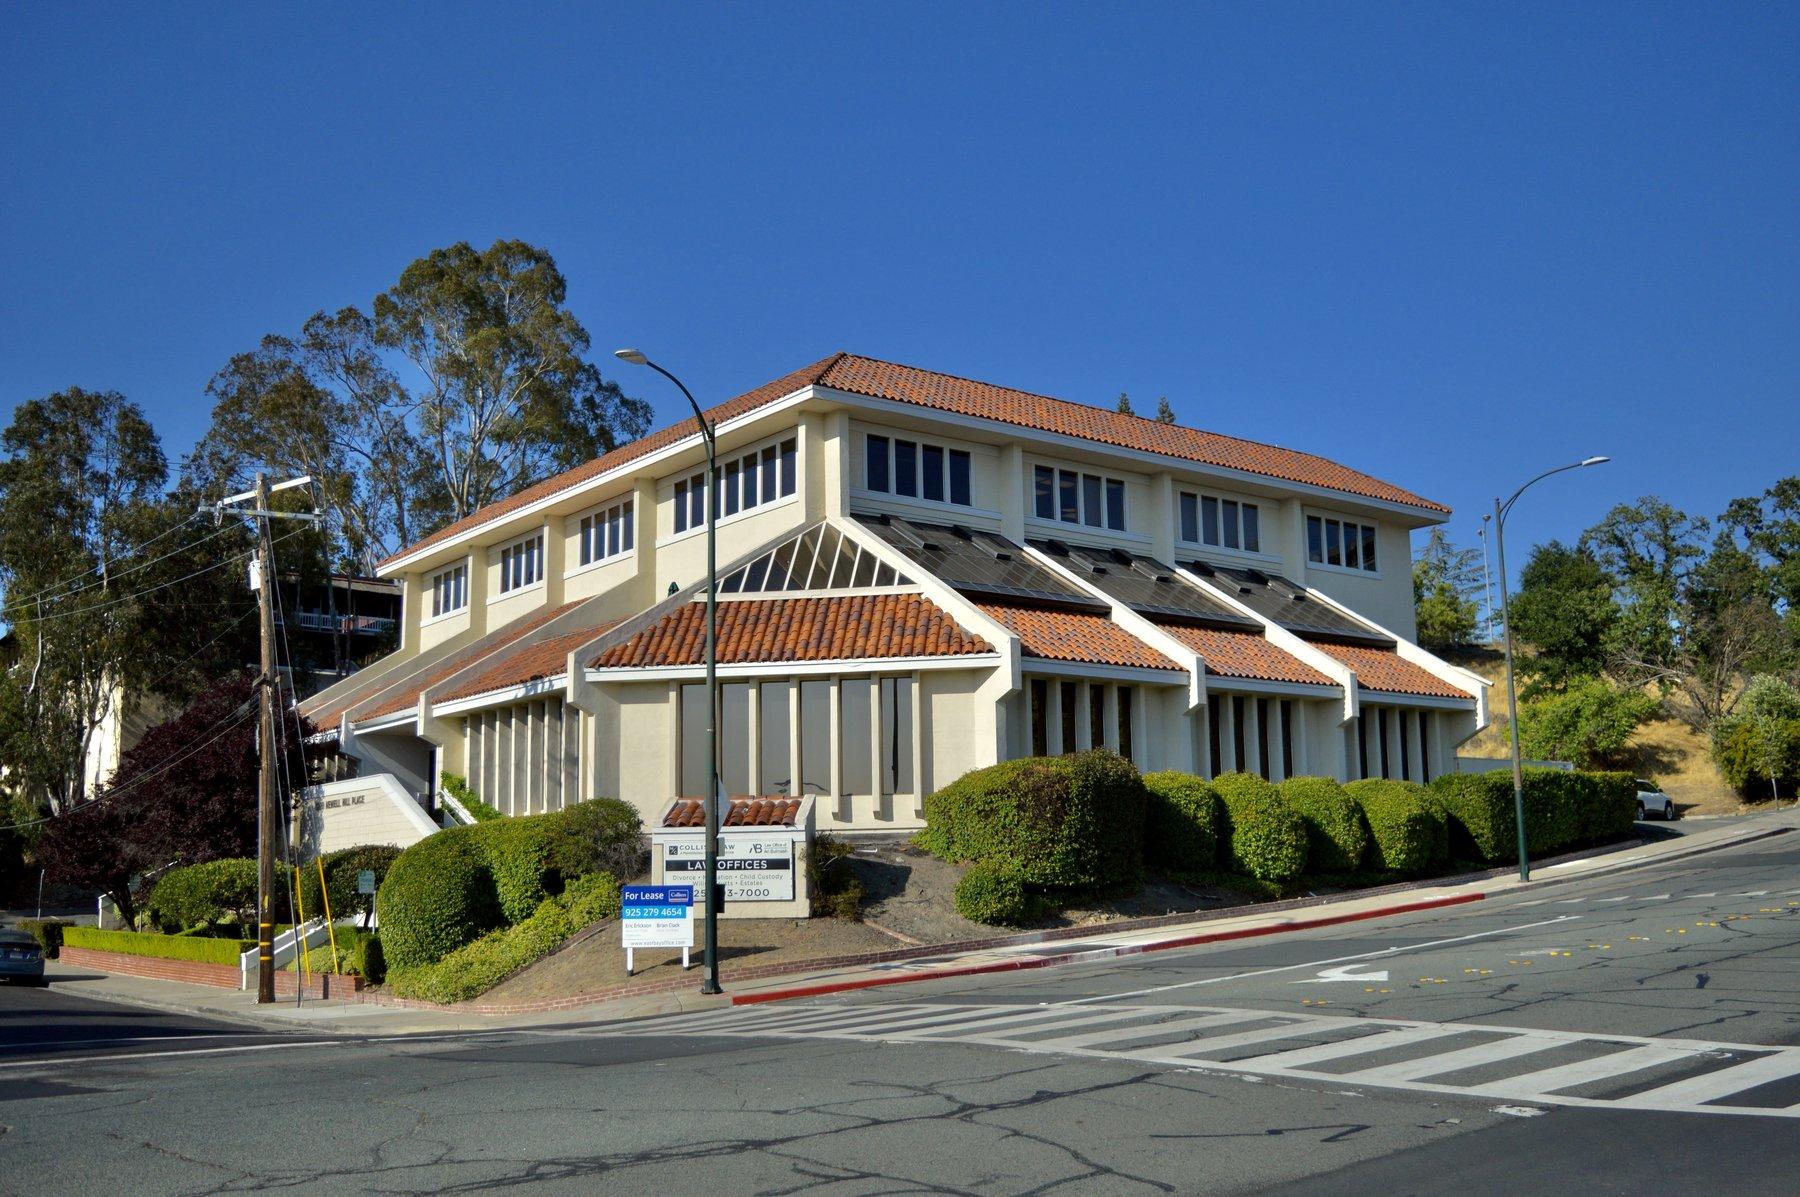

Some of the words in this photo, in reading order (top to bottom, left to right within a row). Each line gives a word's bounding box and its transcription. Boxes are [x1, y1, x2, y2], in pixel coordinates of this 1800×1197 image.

[351, 795, 365, 805] PLACE
[717, 860, 768, 870] OFFICES
[757, 873, 784, 881] Custody
[625, 891, 639, 900] For
[640, 891, 664, 900] Lease
[625, 908, 641, 917] 925
[643, 908, 659, 917] 279
[661, 907, 682, 916] 4654
